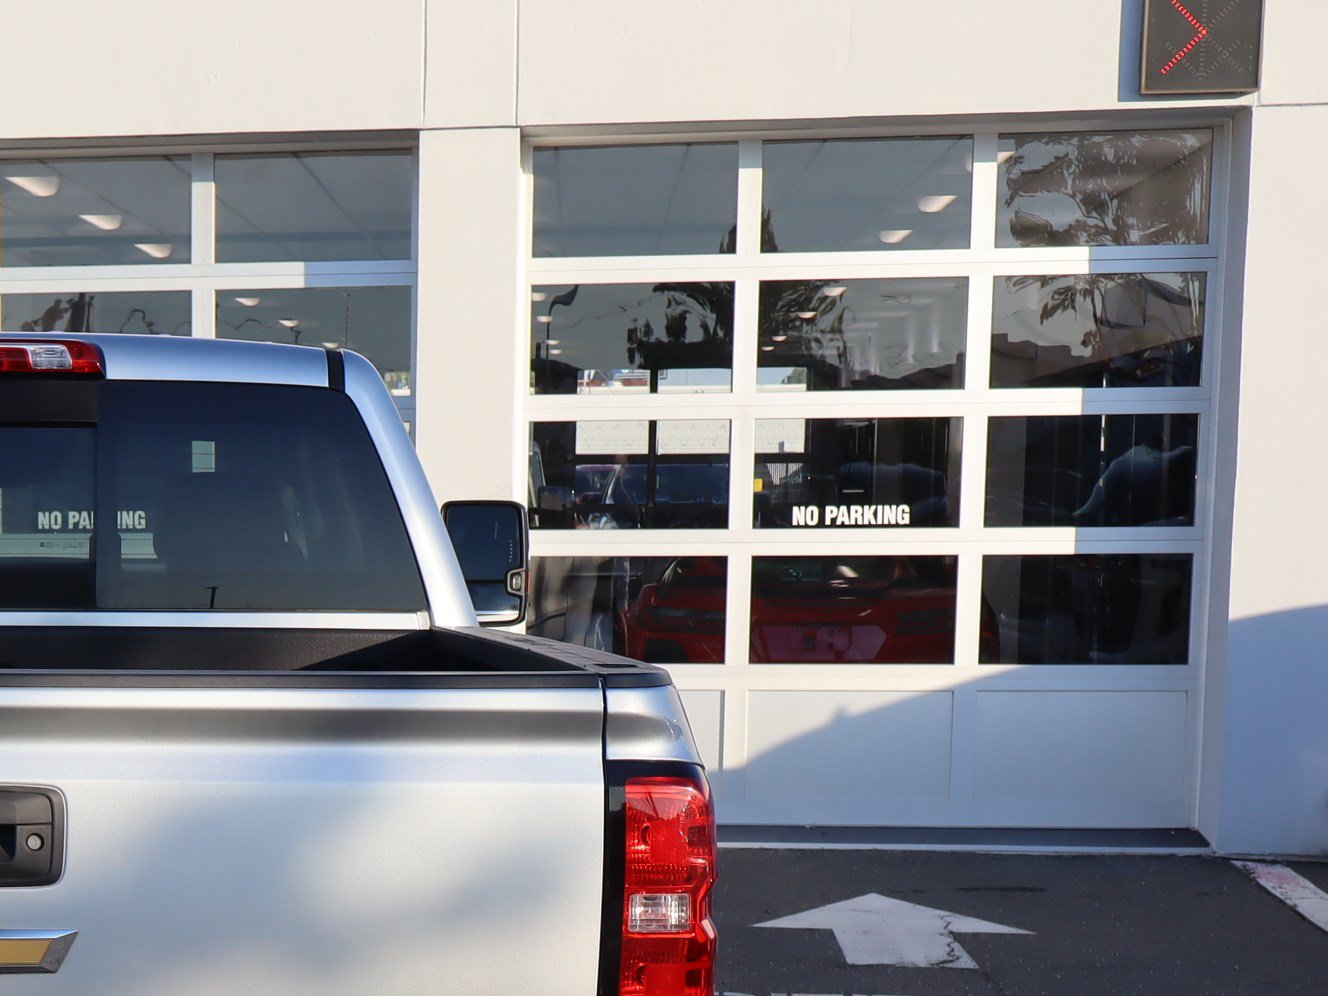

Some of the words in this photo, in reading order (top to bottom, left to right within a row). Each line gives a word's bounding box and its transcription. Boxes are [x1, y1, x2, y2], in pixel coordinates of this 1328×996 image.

[38, 511, 62, 529] NO
[792, 505, 819, 526] NO
[825, 504, 910, 525] PARKING
